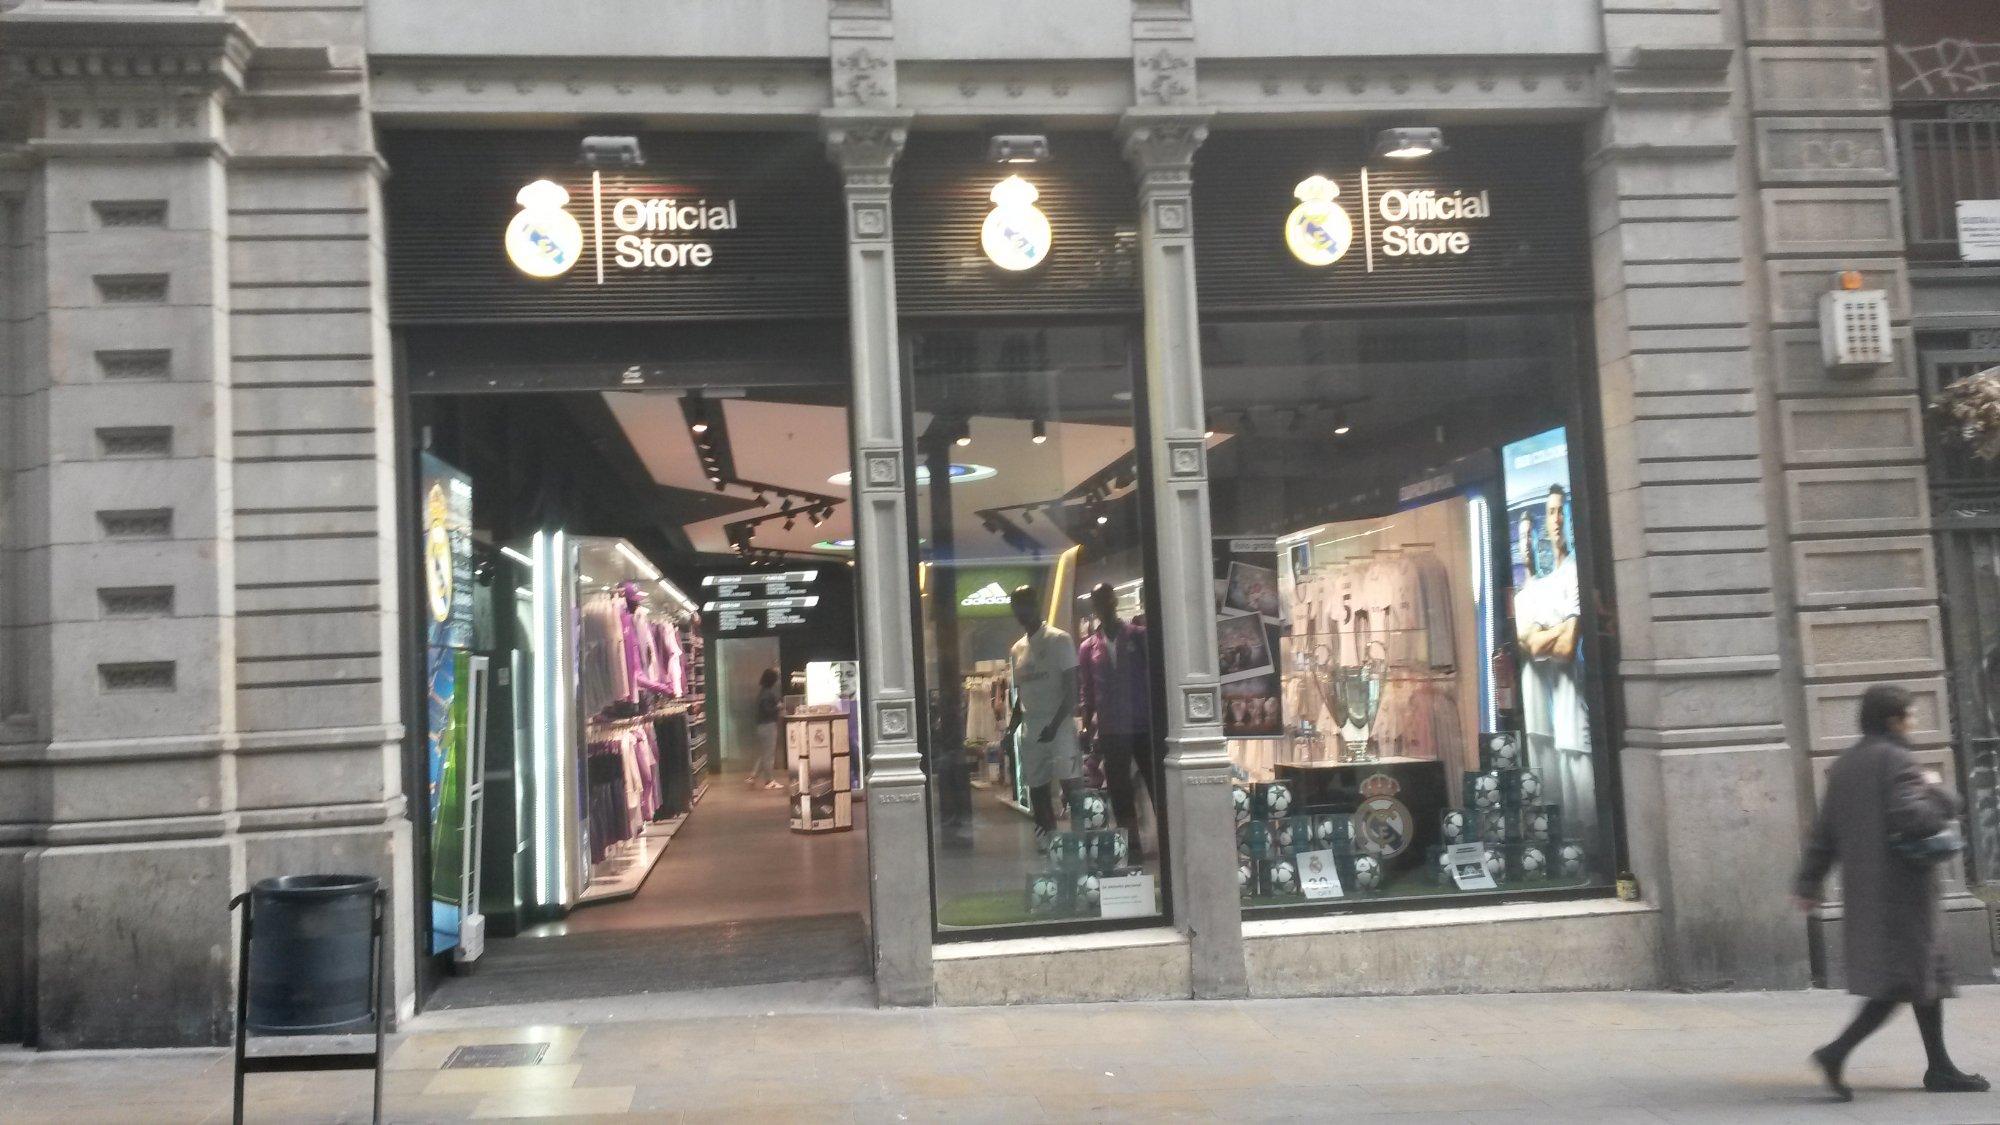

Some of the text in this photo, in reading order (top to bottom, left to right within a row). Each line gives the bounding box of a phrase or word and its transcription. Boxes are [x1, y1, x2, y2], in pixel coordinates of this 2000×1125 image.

[613, 198, 738, 231] Official
[1379, 189, 1490, 221] Official
[615, 235, 713, 268] Store
[1382, 226, 1470, 256] Store
